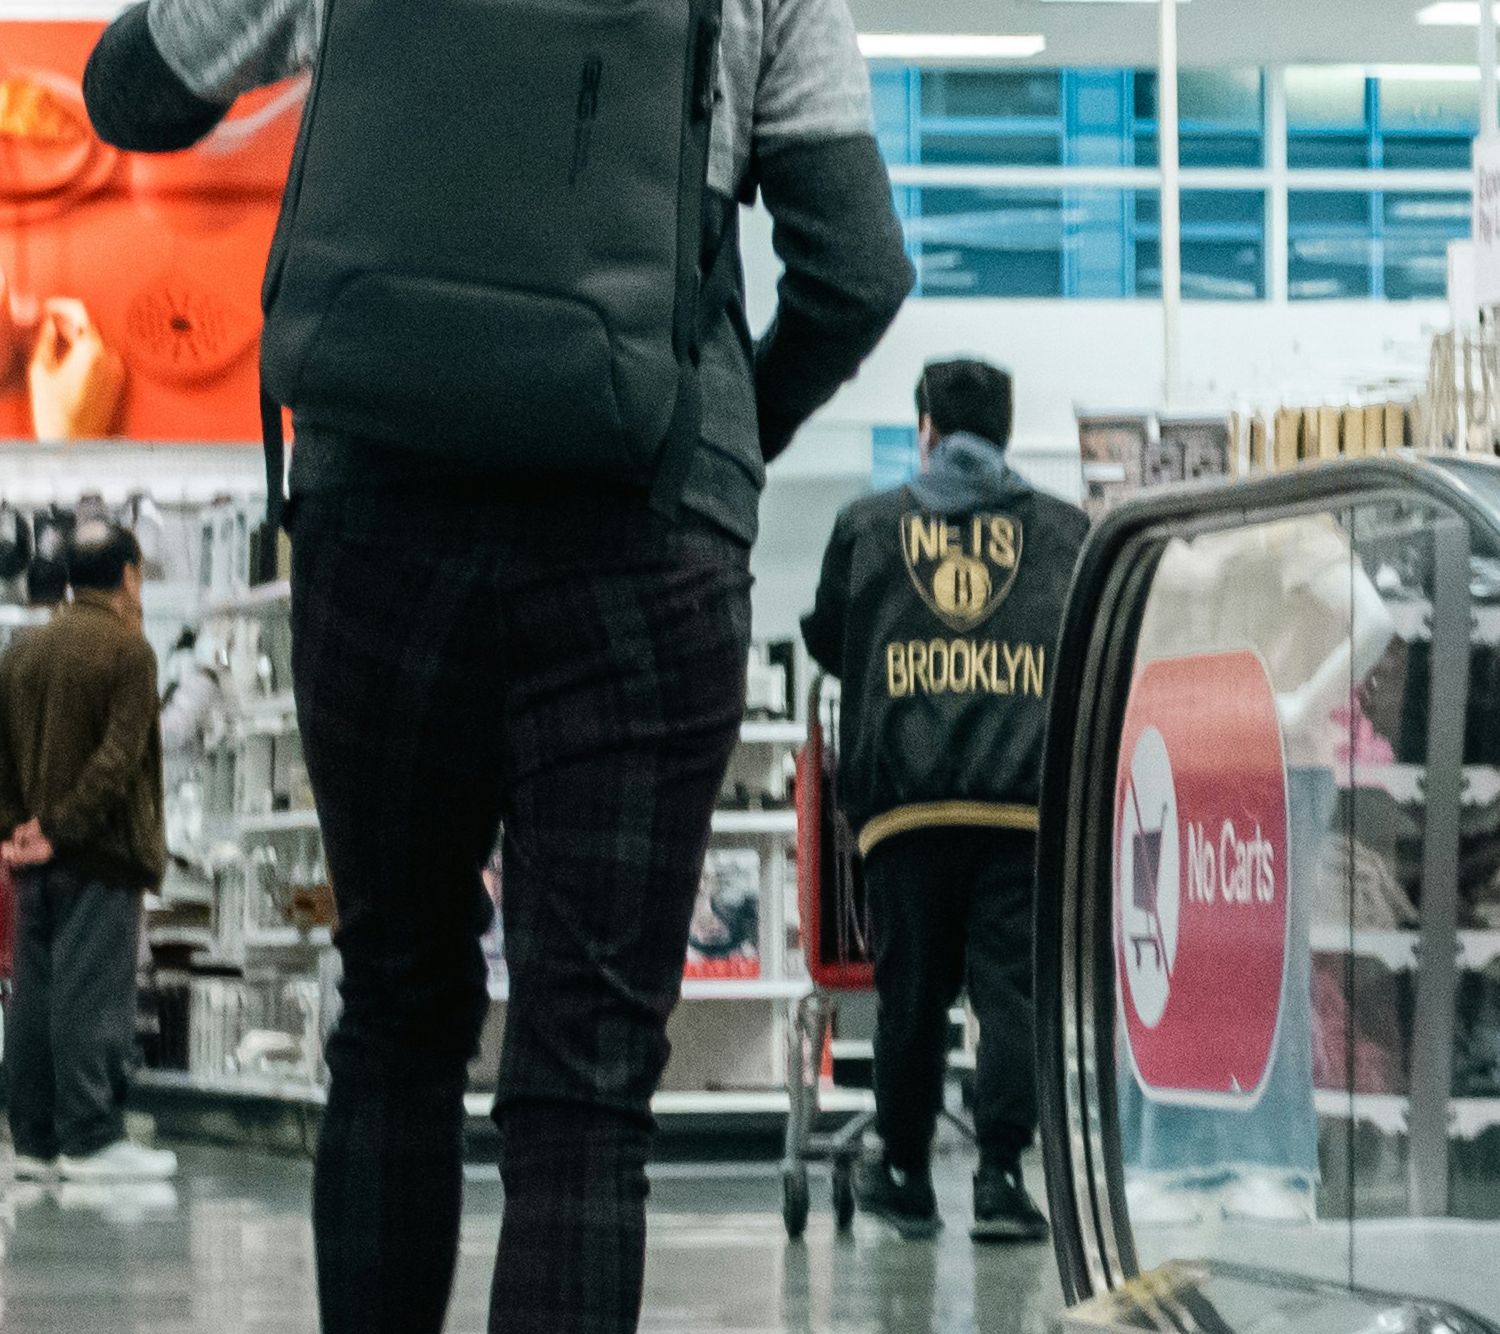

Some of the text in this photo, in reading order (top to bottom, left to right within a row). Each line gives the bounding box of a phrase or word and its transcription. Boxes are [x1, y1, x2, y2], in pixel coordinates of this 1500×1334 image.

[887, 638, 1045, 699] BROOKLYN
[1187, 817, 1275, 906] No Carts
